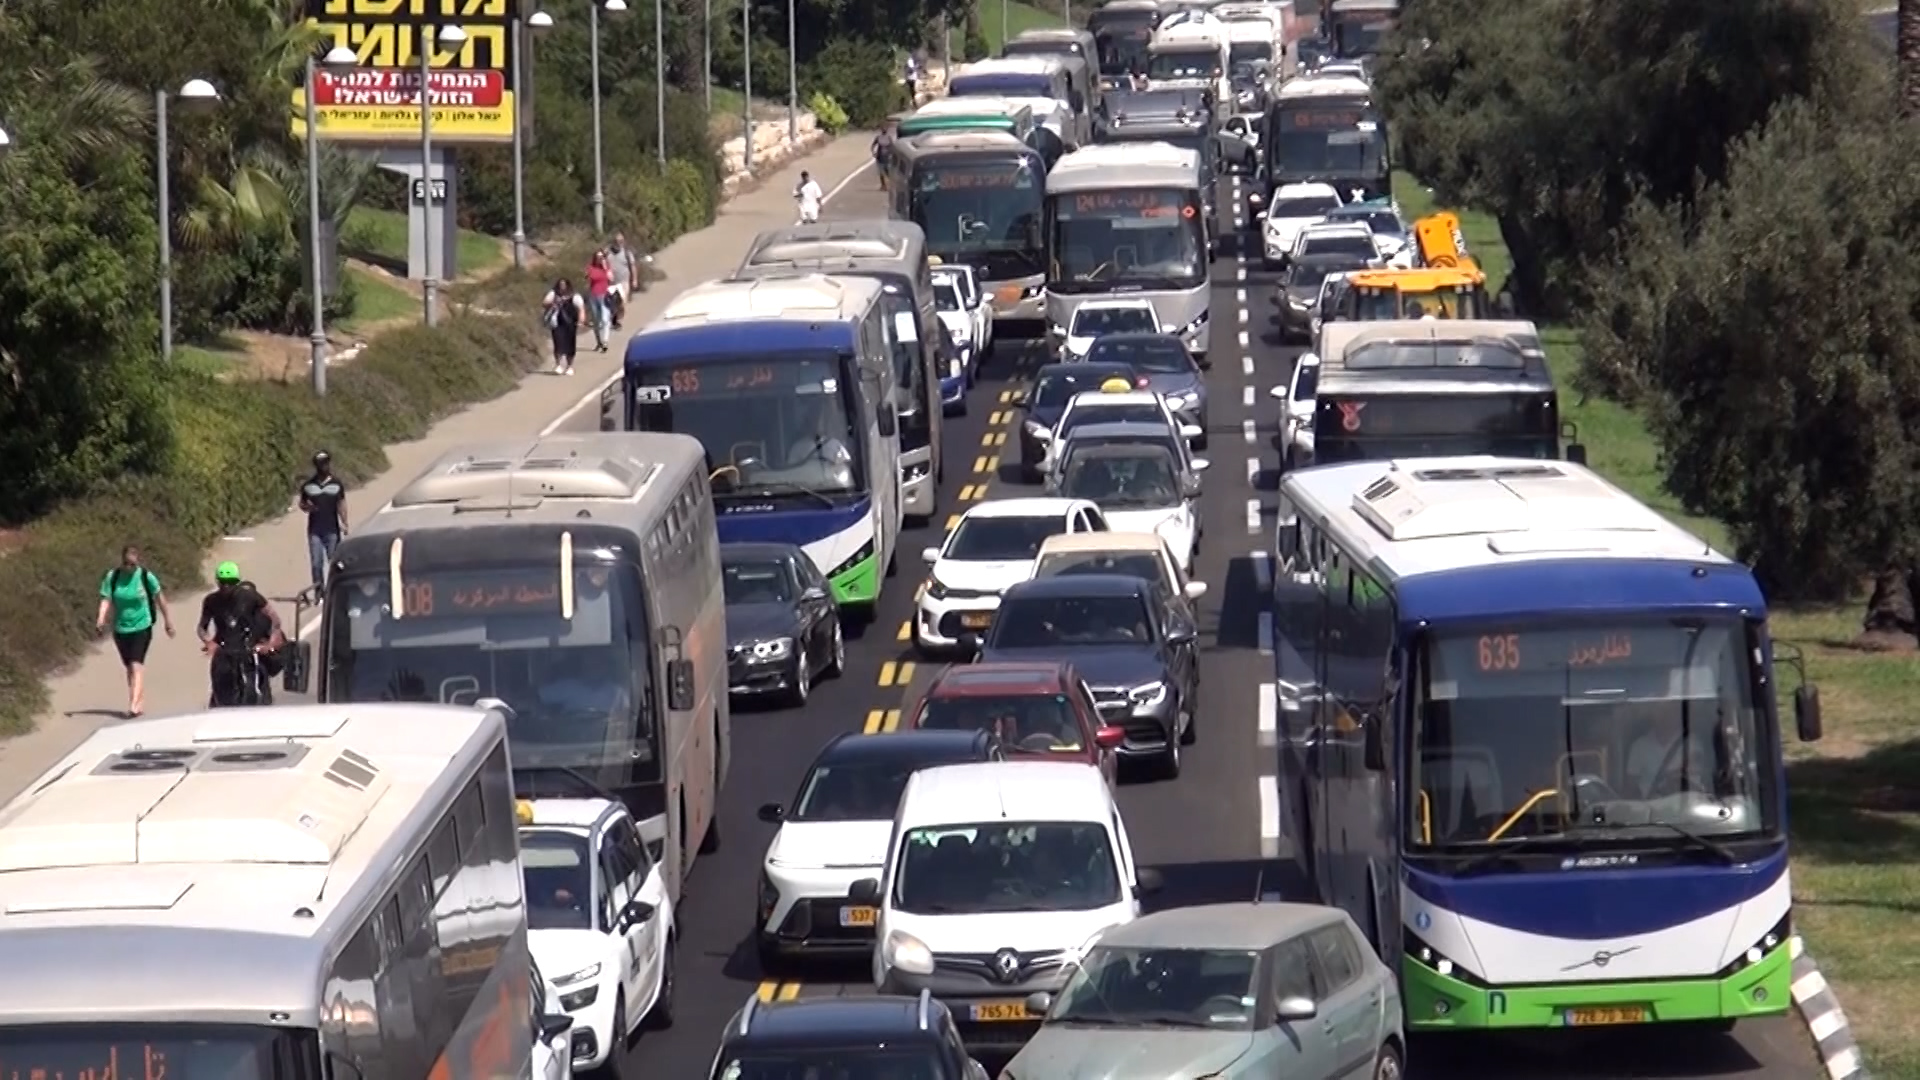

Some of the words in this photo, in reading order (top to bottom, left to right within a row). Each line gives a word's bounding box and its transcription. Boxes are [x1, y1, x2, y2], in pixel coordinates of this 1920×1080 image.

[671, 368, 698, 393] 635
[402, 582, 432, 616] 08
[1479, 635, 1520, 670] 635
